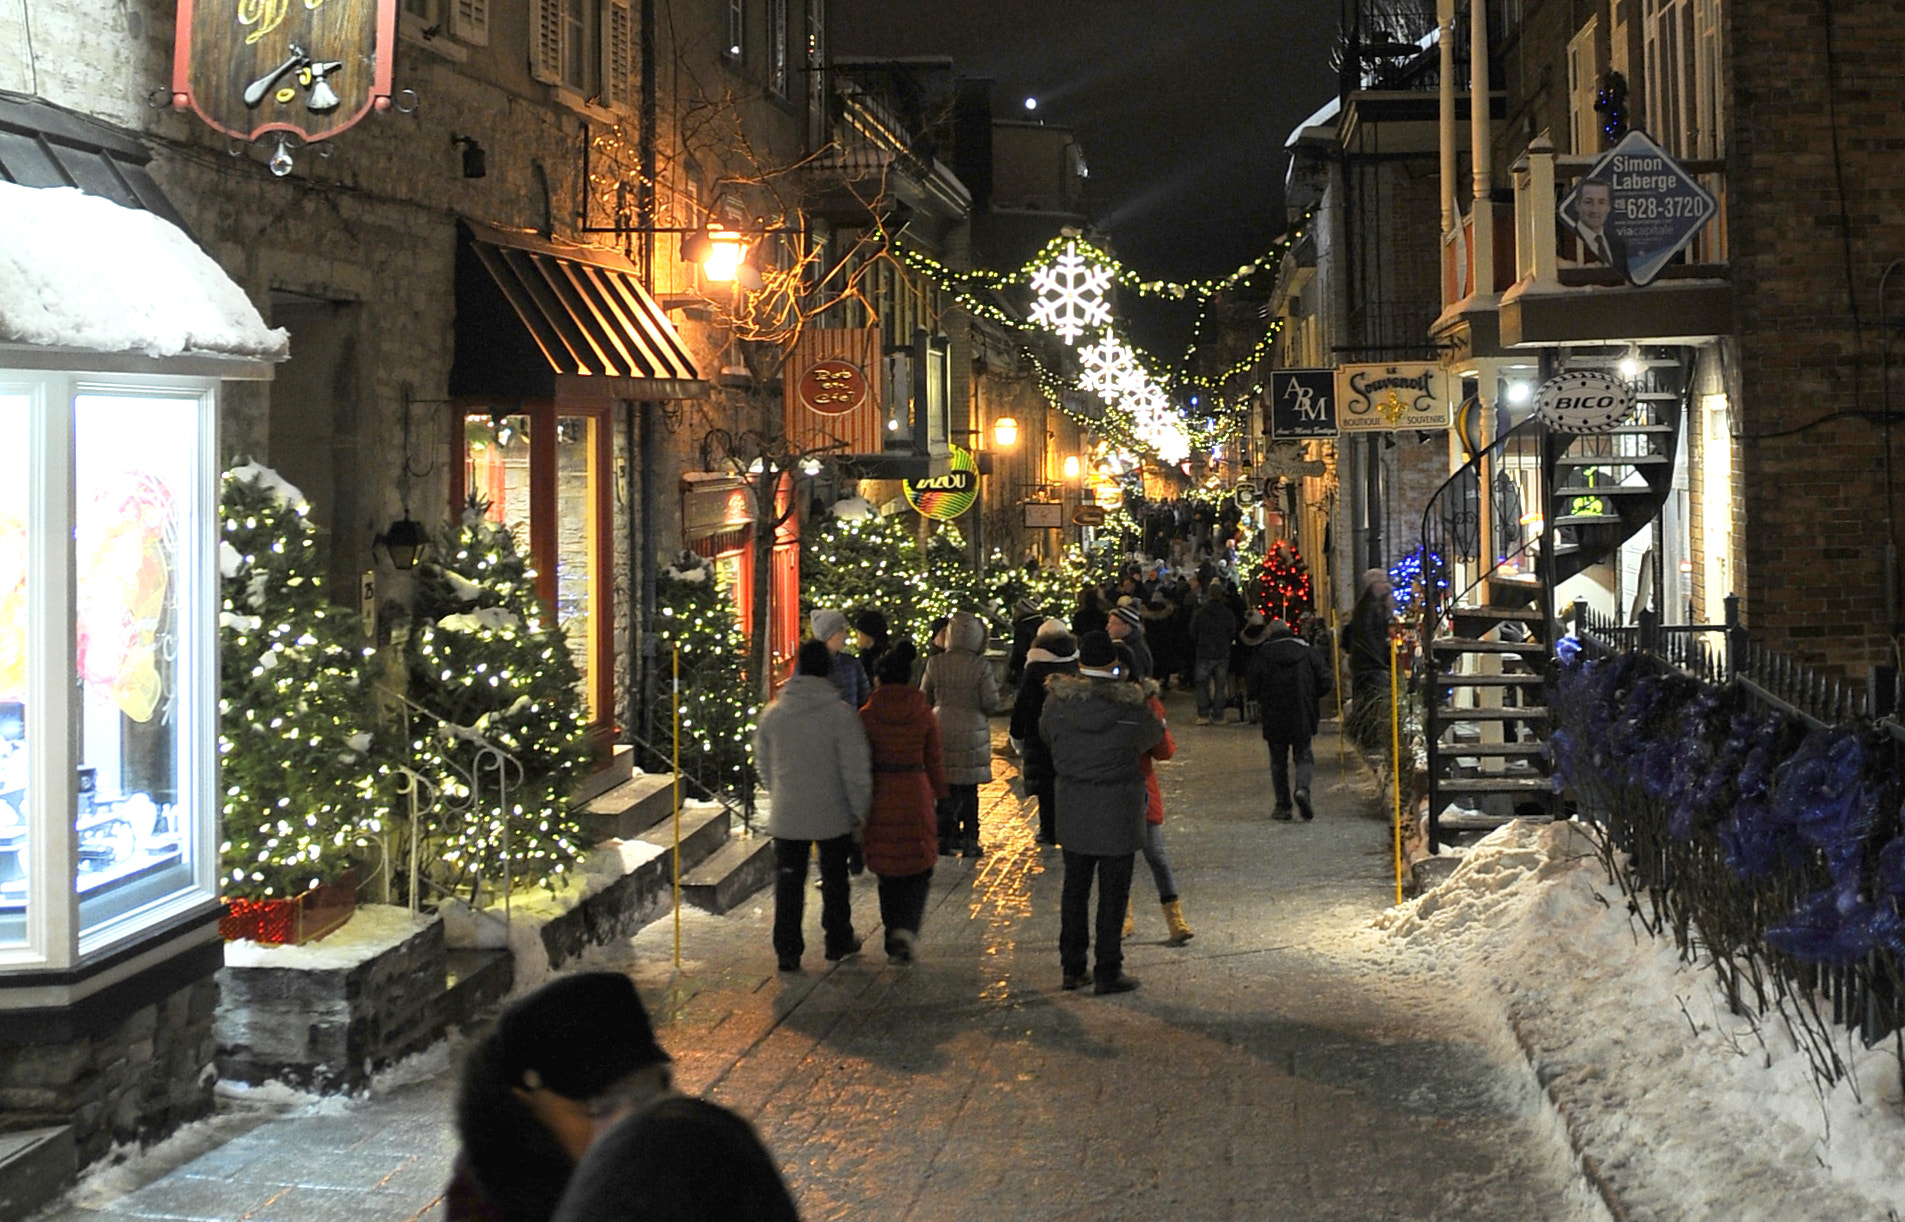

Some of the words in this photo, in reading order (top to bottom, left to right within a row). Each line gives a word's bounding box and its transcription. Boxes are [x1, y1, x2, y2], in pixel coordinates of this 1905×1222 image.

[1613, 156, 1662, 172] Simon
[1612, 174, 1677, 192] Laberge
[1627, 196, 1704, 219] 628-3720
[1555, 396, 1614, 409] BICO
[1343, 417, 1381, 427] BOUTIQUE
[1407, 415, 1446, 425] SOUVENIRS
